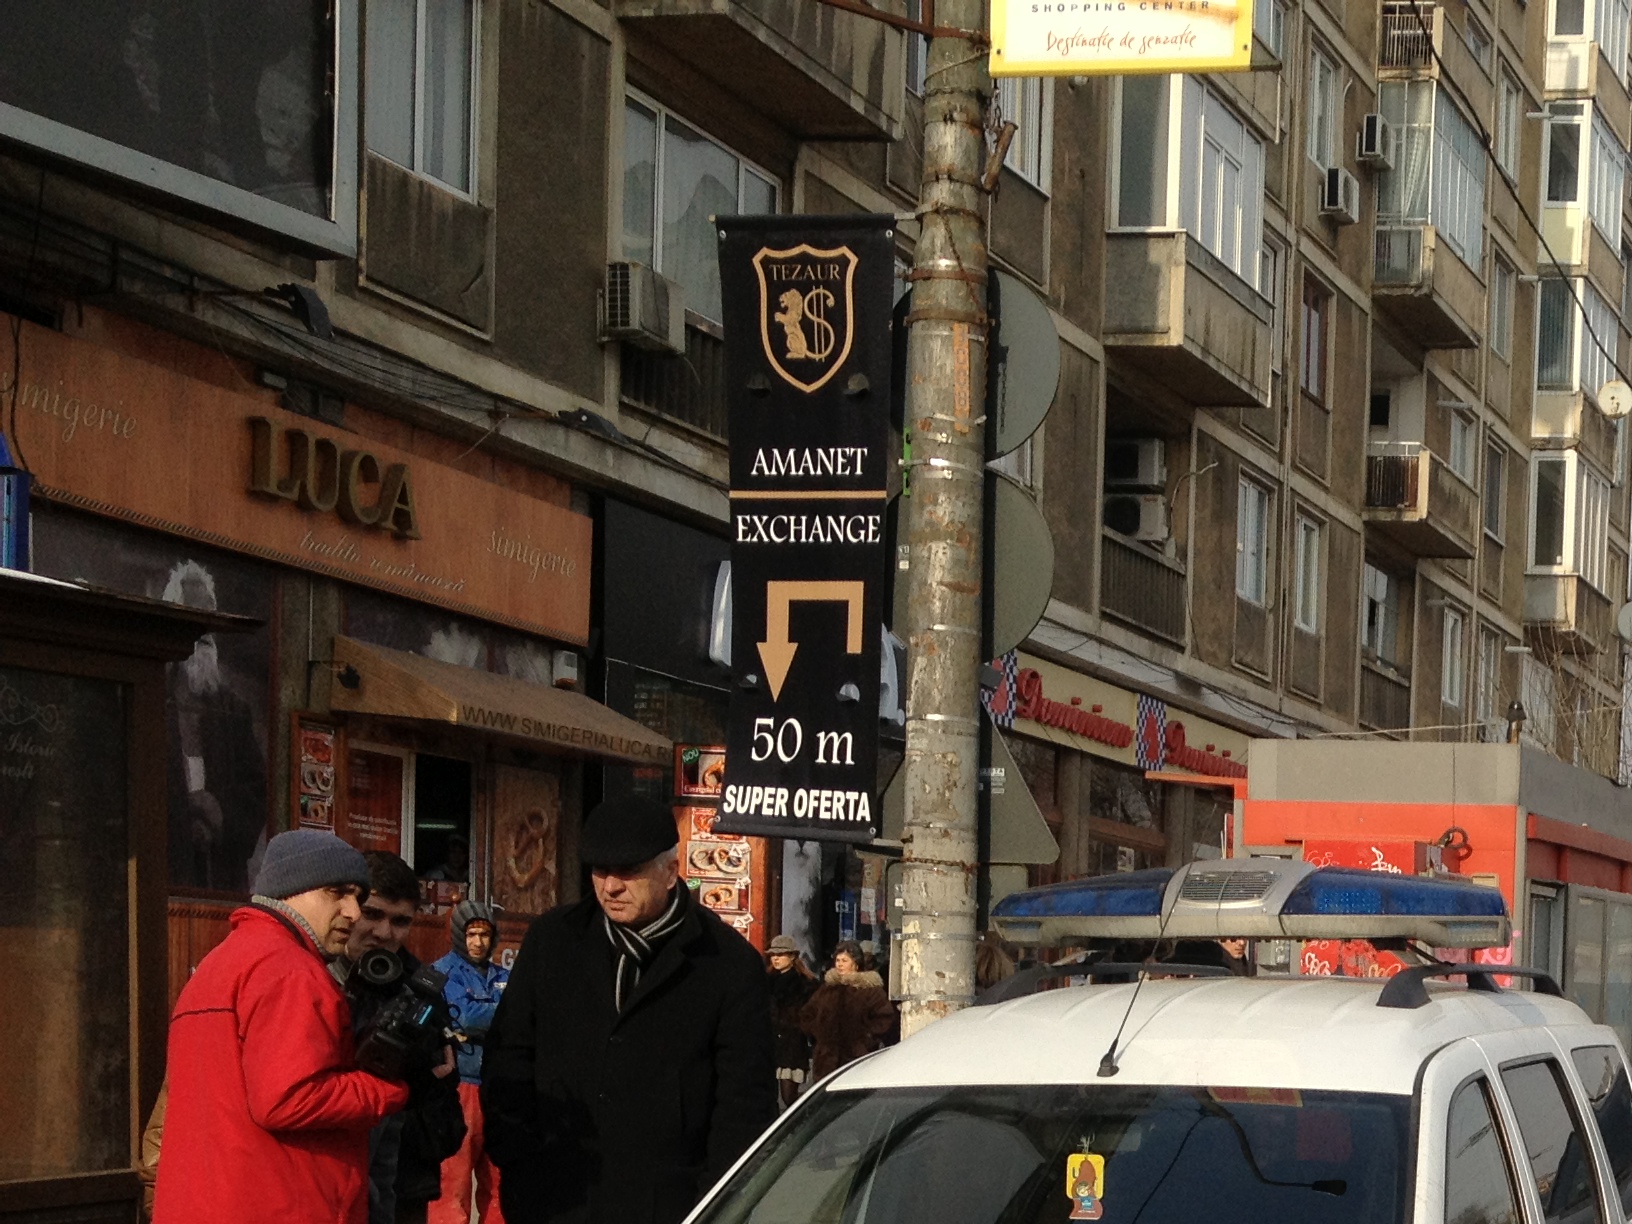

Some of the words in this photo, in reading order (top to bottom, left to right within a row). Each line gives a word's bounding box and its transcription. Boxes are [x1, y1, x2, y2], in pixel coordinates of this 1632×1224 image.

[1031, 2, 1126, 13] SHOPPING
[1139, 1, 1210, 11] CENTER
[1119, 30, 1135, 49] de
[769, 264, 841, 281] TEZAUR
[751, 447, 868, 476] AMANET
[247, 416, 421, 541] LUCA
[736, 515, 881, 543] EXCHANGE
[487, 526, 577, 583] simigerie
[751, 716, 803, 762] 50
[815, 730, 855, 765] m
[682, 748, 699, 763] NOU
[723, 785, 789, 817] SUPER
[793, 788, 871, 822] OFERTA
